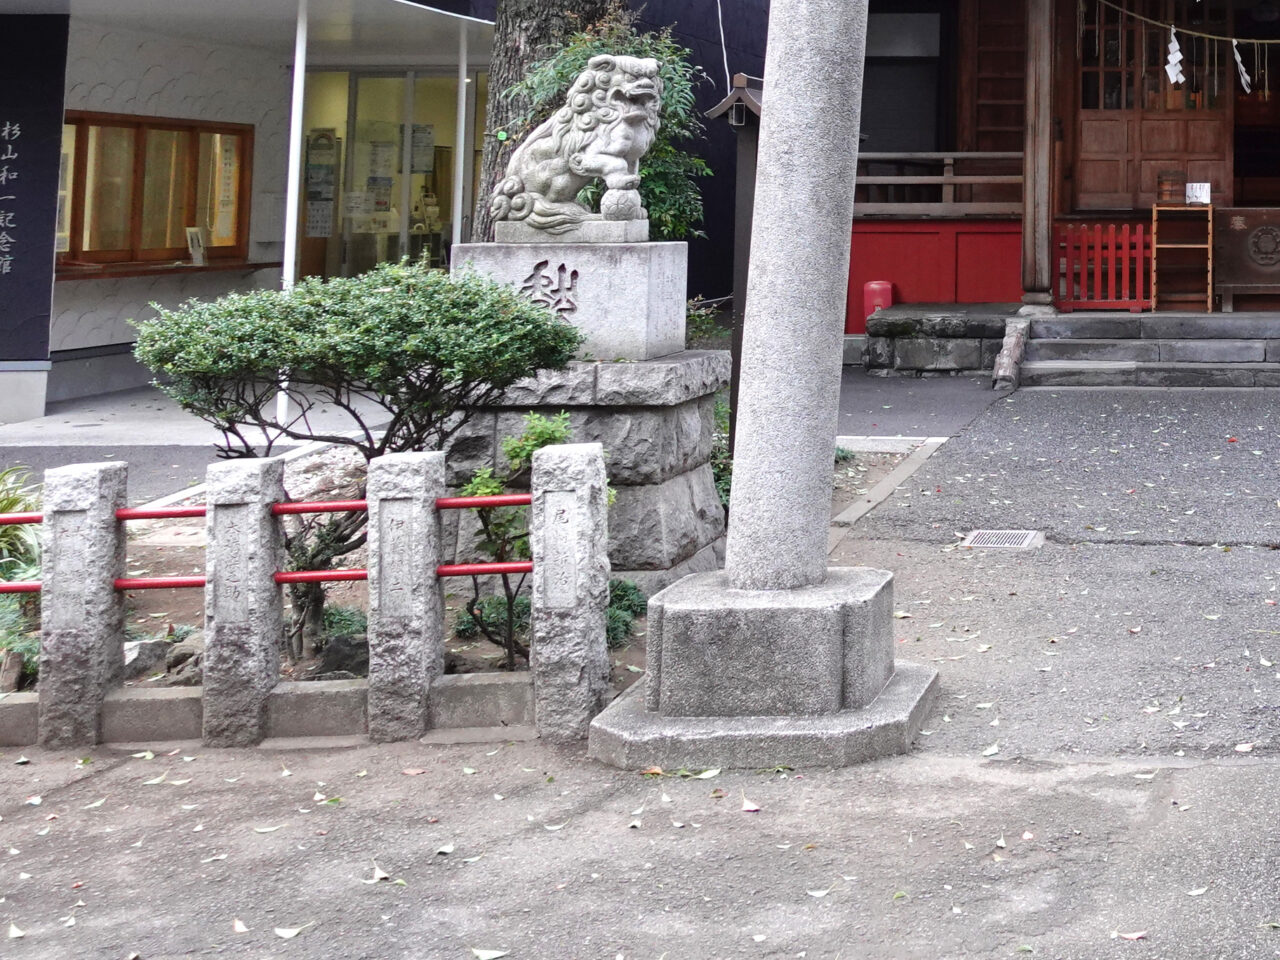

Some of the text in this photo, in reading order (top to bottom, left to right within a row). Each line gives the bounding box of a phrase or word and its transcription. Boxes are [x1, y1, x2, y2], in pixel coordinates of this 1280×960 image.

[0, 121, 21, 274] 杉山和一記念館
